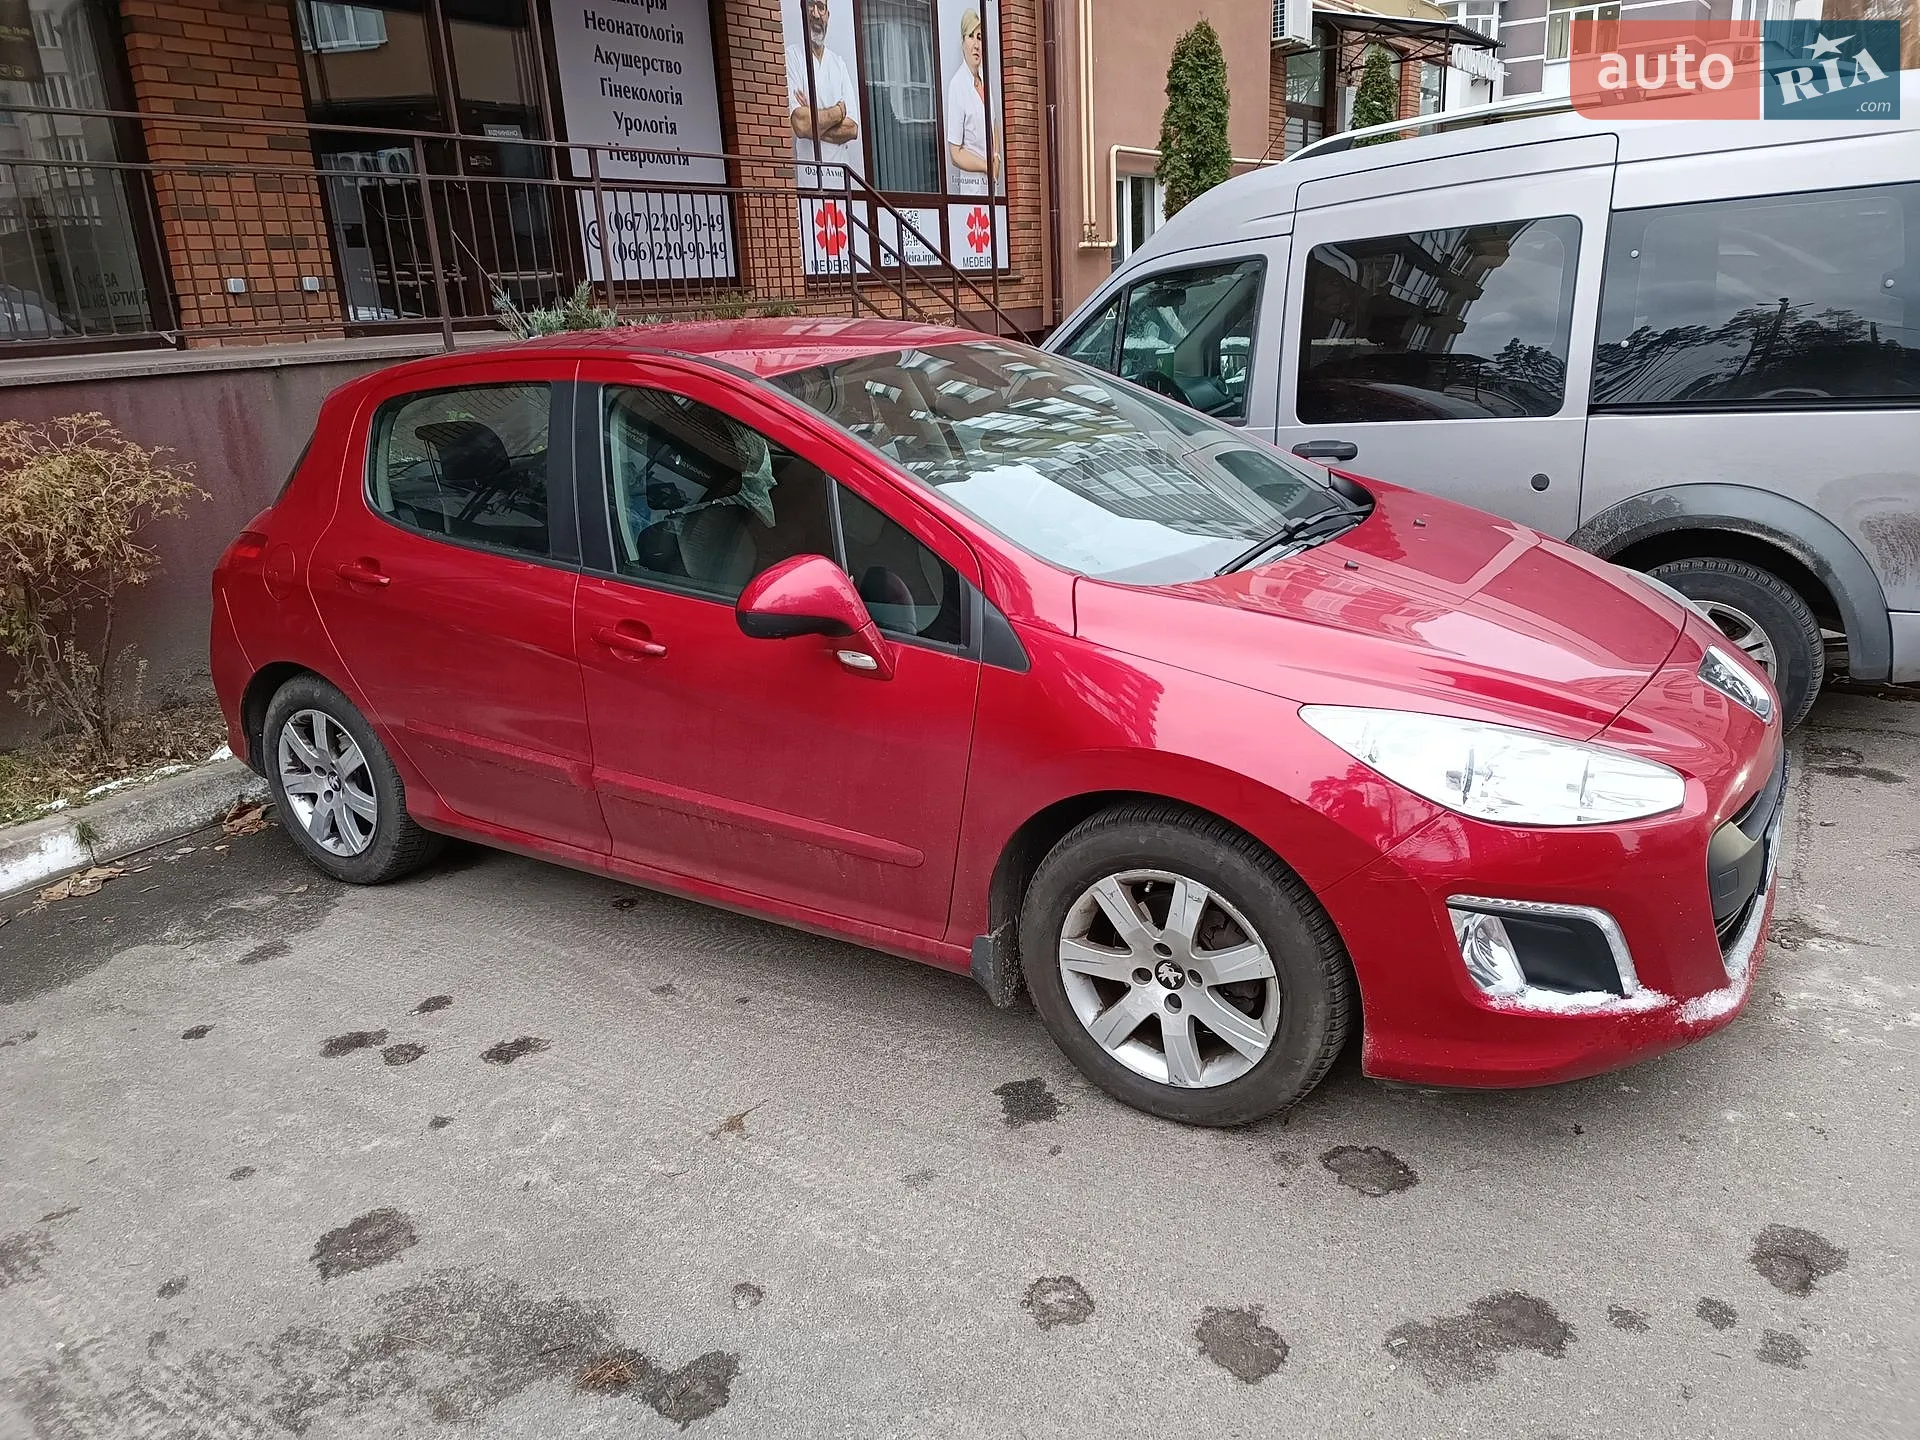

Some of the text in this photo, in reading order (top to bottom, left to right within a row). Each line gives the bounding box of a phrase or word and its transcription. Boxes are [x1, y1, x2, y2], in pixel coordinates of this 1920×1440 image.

[583, 9, 684, 45] Неонатологія
[593, 44, 682, 76] Акушерство
[600, 77, 683, 106] Гінекологія
[613, 110, 677, 137] Урологія
[607, 142, 690, 168] Неврологія
[811, 259, 850, 273] MEDEIR
[962, 256, 992, 268] MEDEIR
